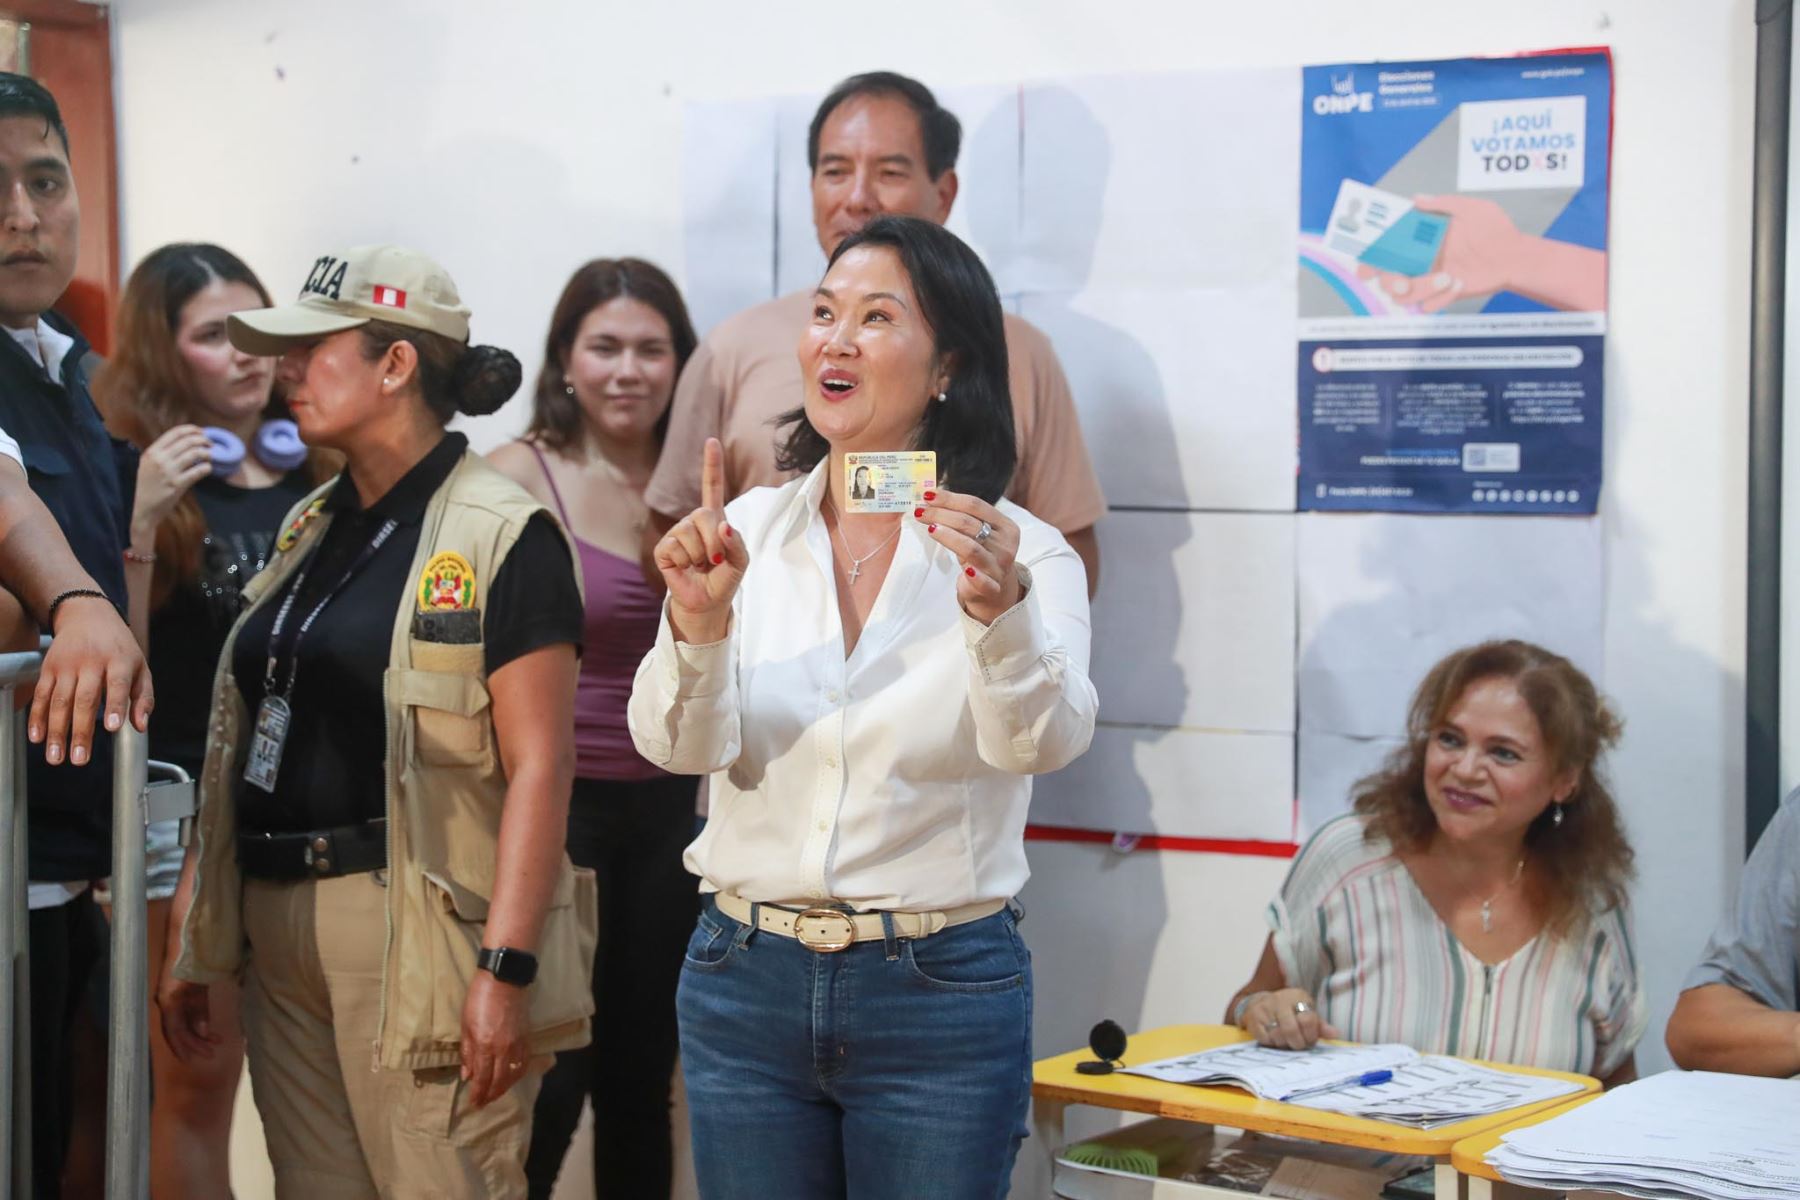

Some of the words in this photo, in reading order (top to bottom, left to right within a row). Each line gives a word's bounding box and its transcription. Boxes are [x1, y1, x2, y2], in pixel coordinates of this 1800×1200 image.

[1312, 92, 1374, 115] ONPE
[1471, 133, 1576, 153] VOTAMOS
[301, 256, 348, 300] CIA
